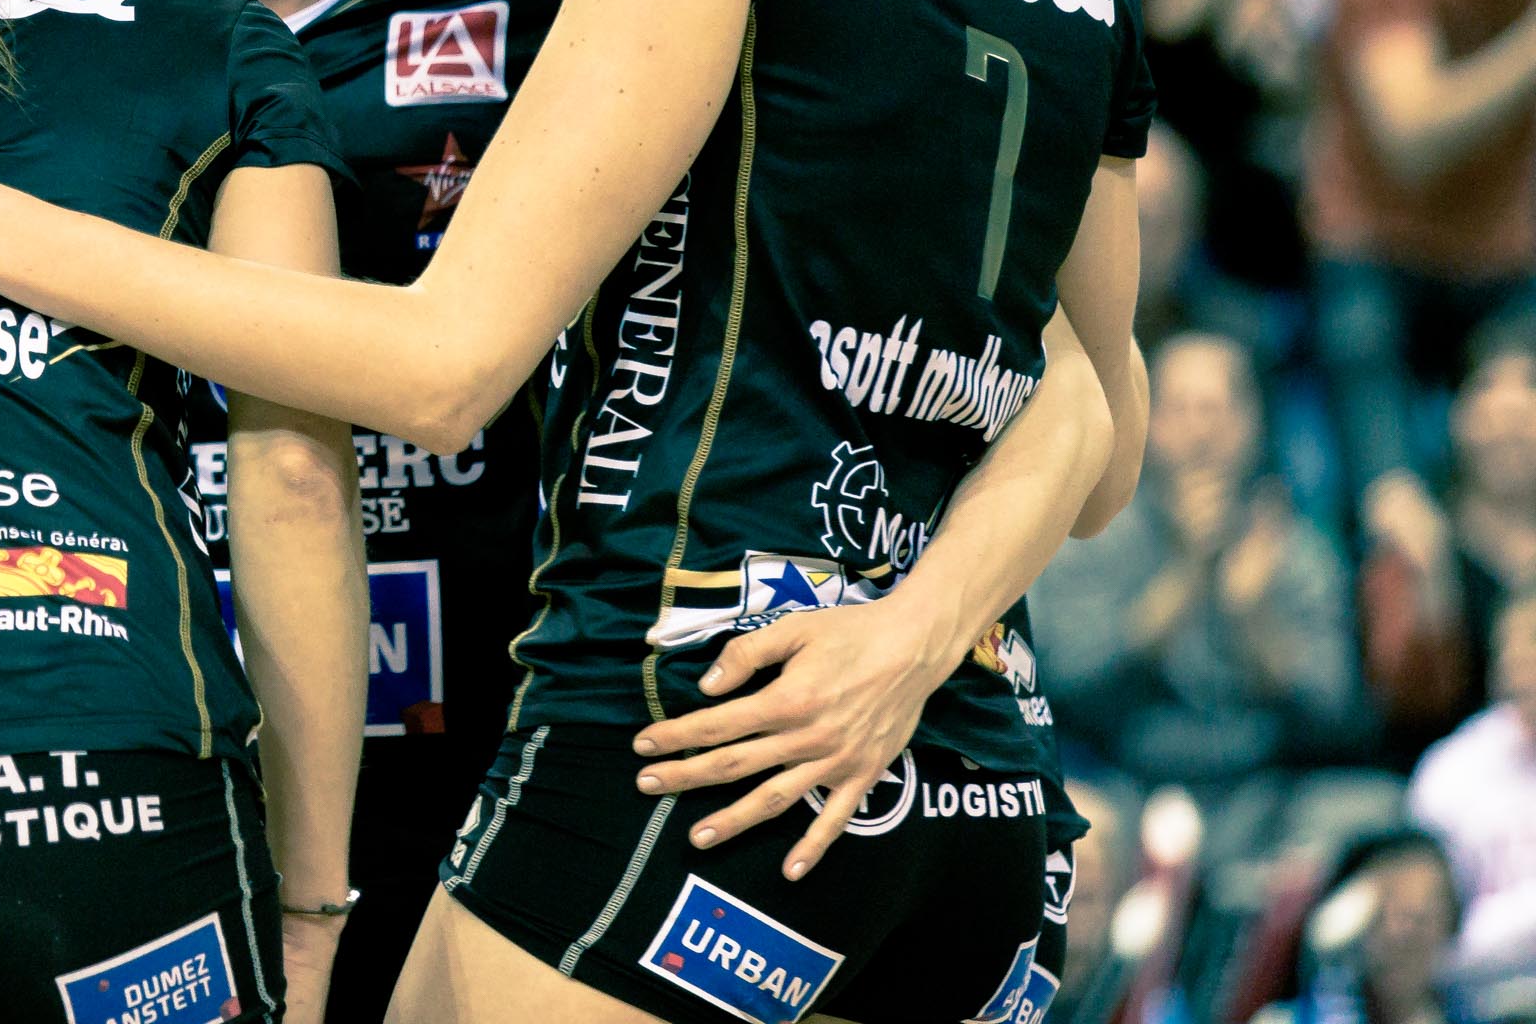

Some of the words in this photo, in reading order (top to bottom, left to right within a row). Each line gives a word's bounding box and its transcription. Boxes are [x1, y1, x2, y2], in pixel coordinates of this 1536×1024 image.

[965, 24, 1029, 301] 7
[50, 530, 129, 553] Général
[123, 952, 210, 1009] DUMEZ
[680, 917, 812, 1009] URBAN
